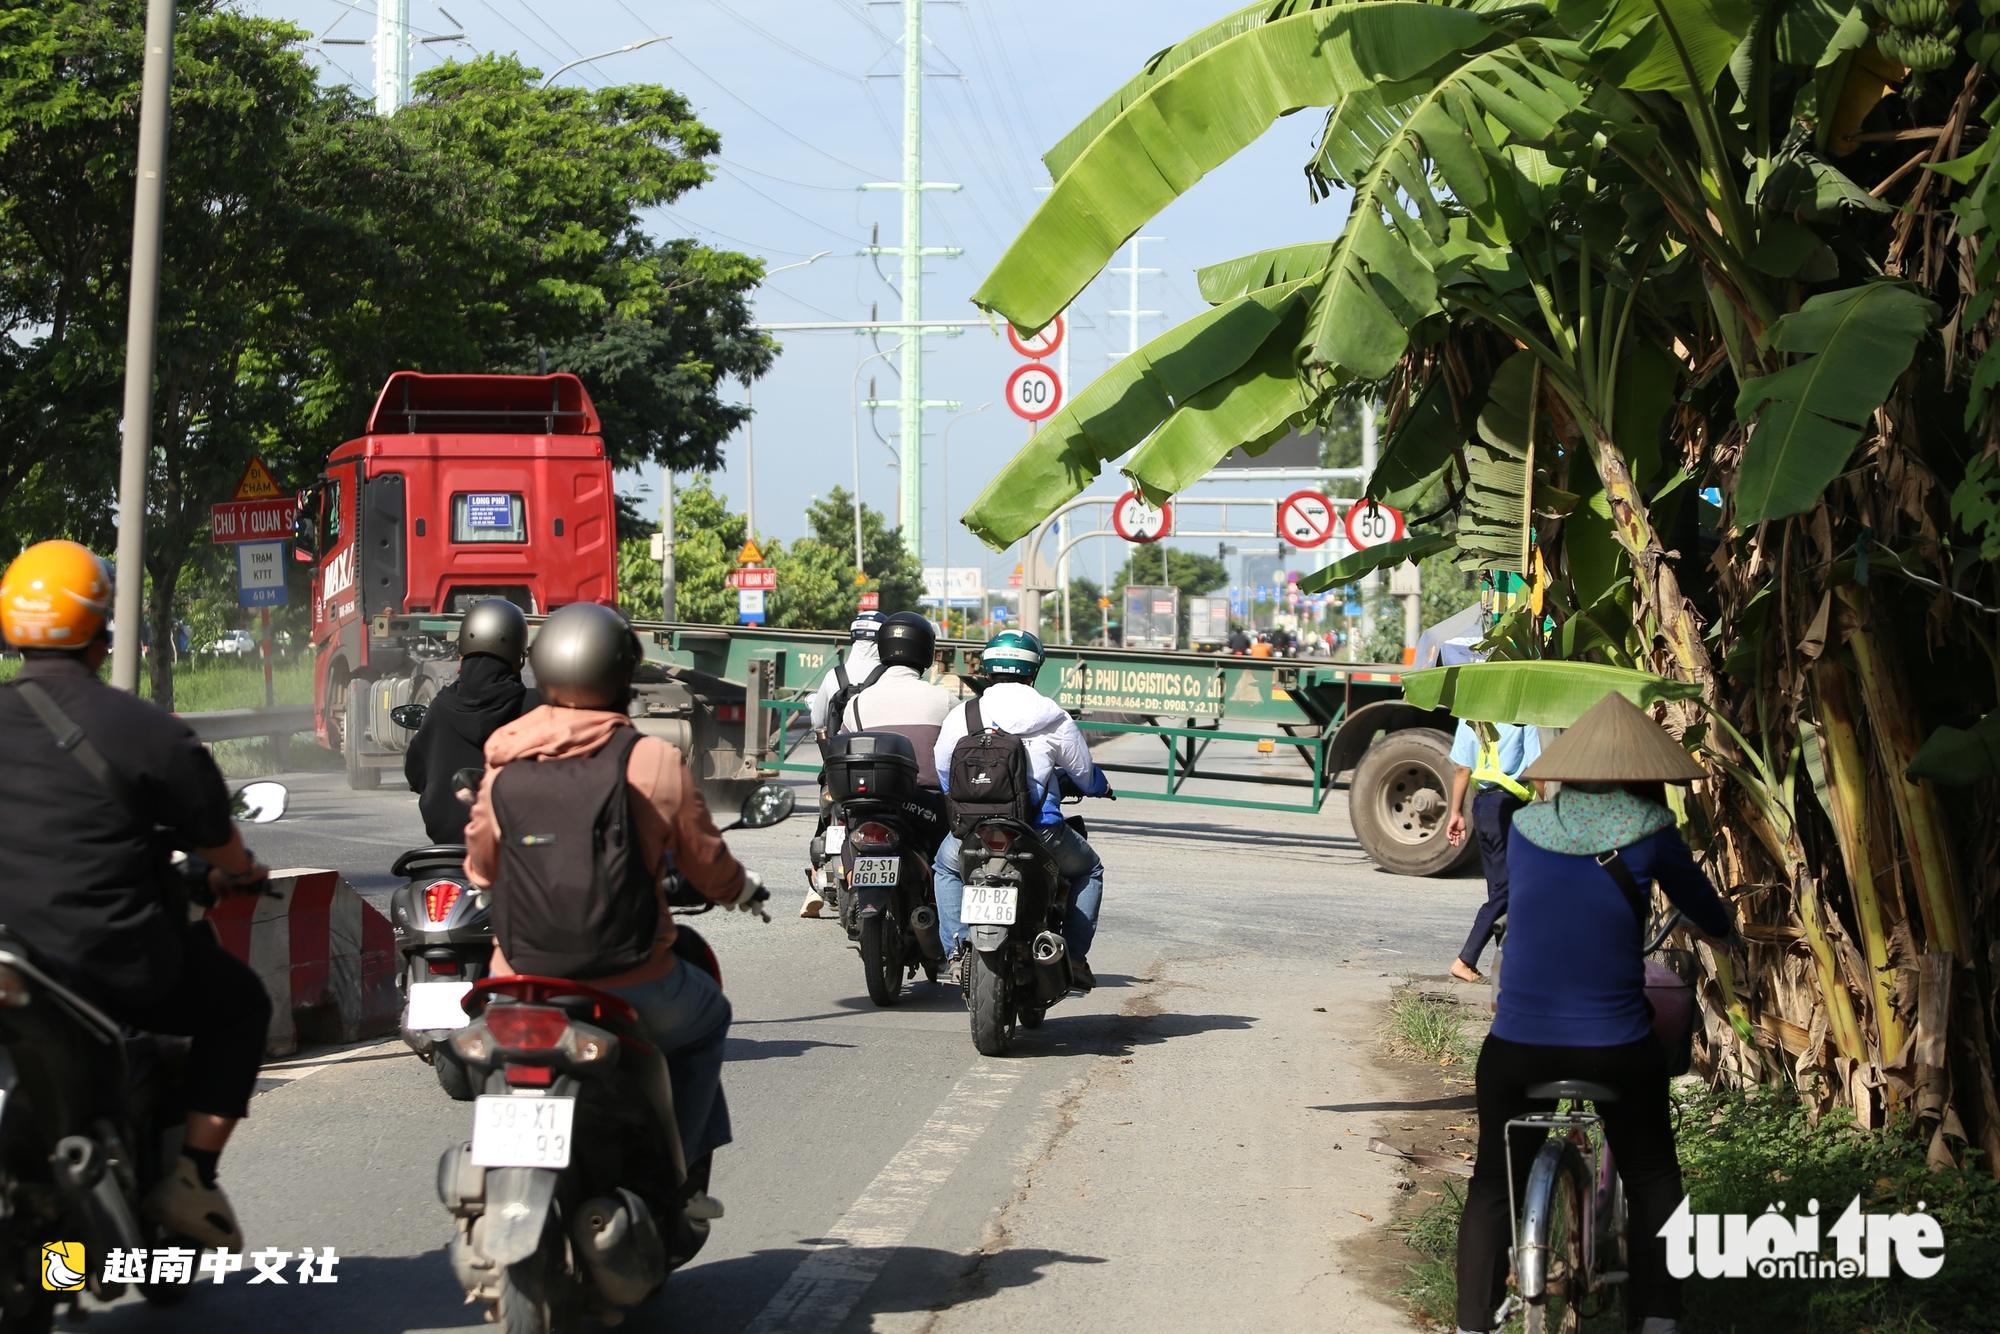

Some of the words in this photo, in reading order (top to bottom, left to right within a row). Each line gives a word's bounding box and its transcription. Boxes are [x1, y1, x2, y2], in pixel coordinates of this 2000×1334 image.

[1023, 380, 1046, 403] 60
[472, 497, 490, 505] LONG
[214, 507, 236, 535] CHÚ
[240, 506, 247, 534] Ý
[251, 509, 281, 533] QUAN
[1362, 514, 1386, 538] 50
[1060, 667, 1094, 690] LONG
[1095, 669, 1120, 692] PHU
[1121, 671, 1181, 697] LOGISTICS
[859, 859, 893, 872] 29-S1
[854, 872, 896, 885] 860.58
[971, 888, 1009, 905] 70-B2
[966, 905, 1013, 921] 124.86
